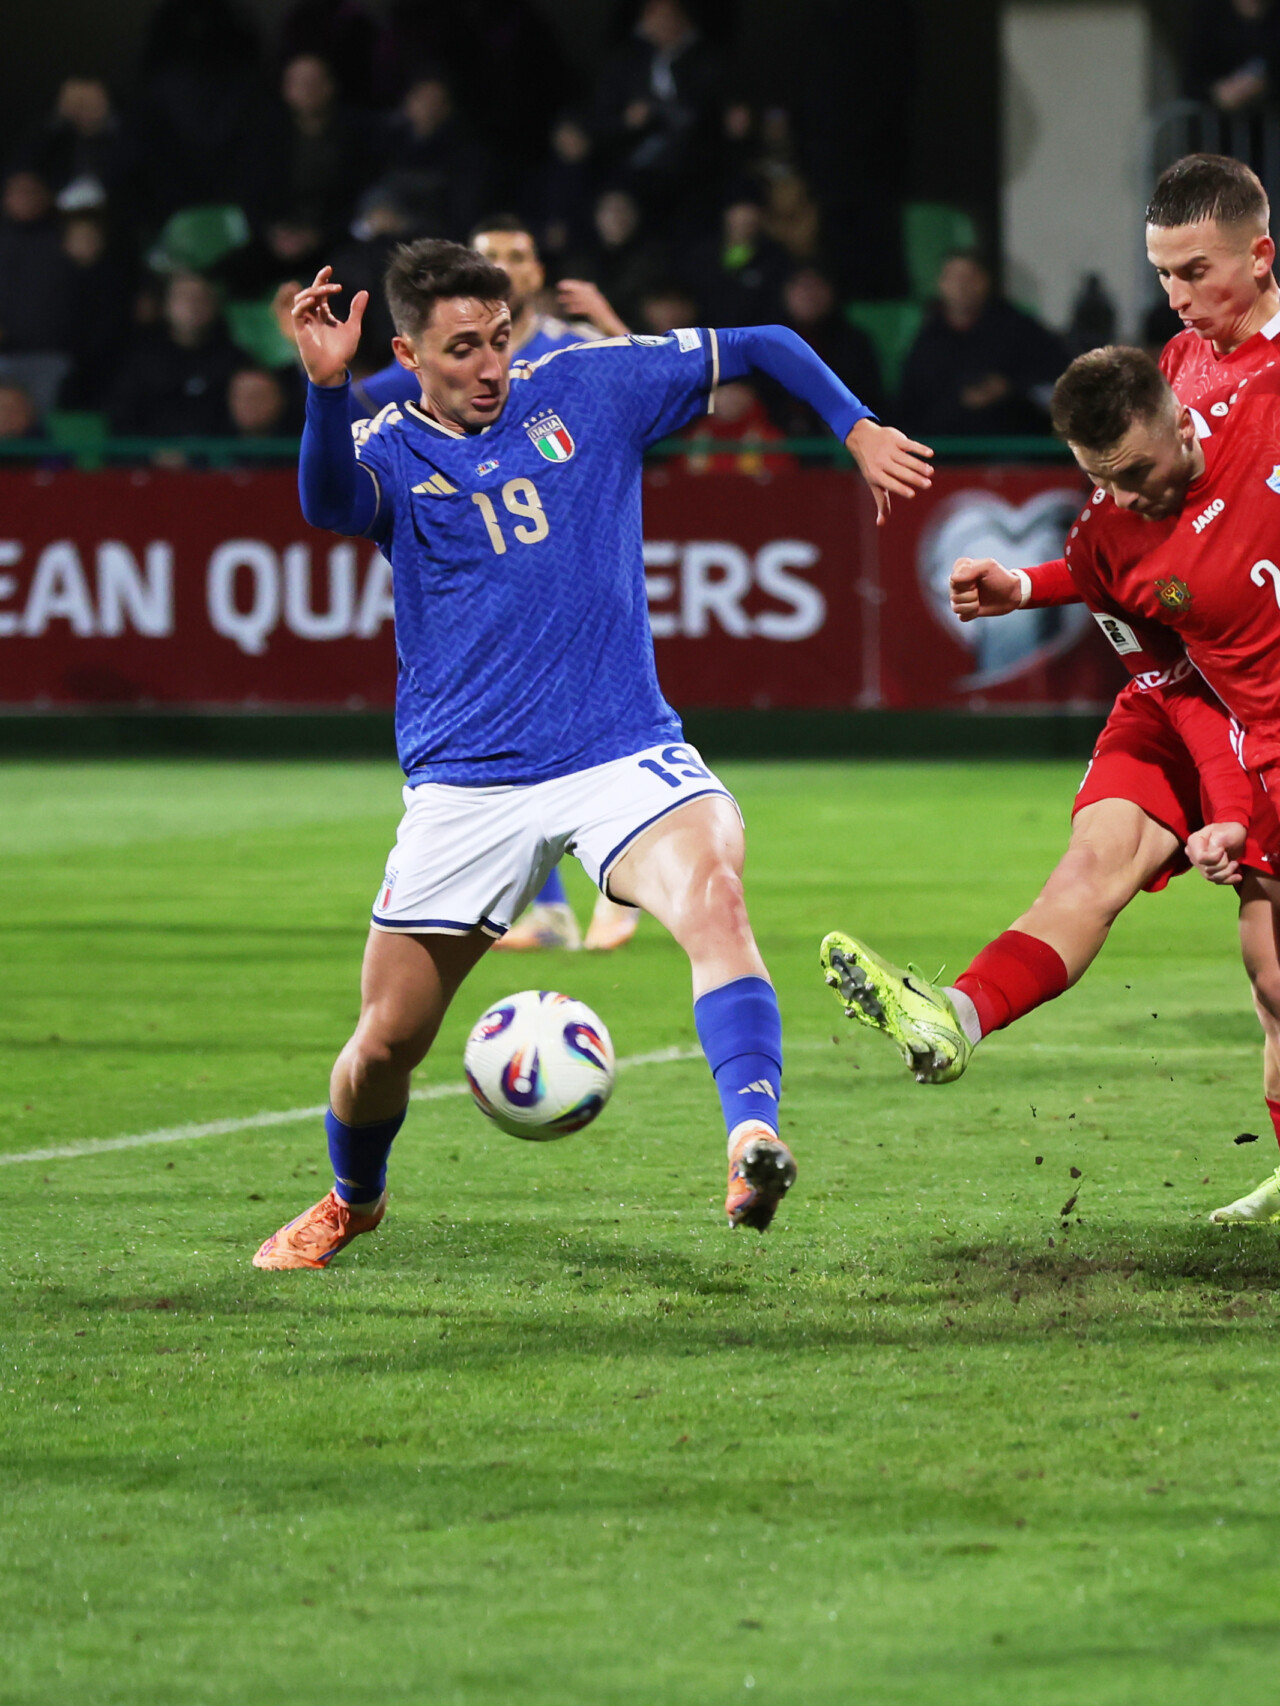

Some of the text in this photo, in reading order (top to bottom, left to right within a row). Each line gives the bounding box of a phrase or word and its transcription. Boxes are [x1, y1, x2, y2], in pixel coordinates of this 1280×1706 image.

[530, 419, 560, 438] ITALIA
[471, 477, 549, 554] 19
[1191, 498, 1225, 534] JAKO
[638, 746, 711, 788] 19
